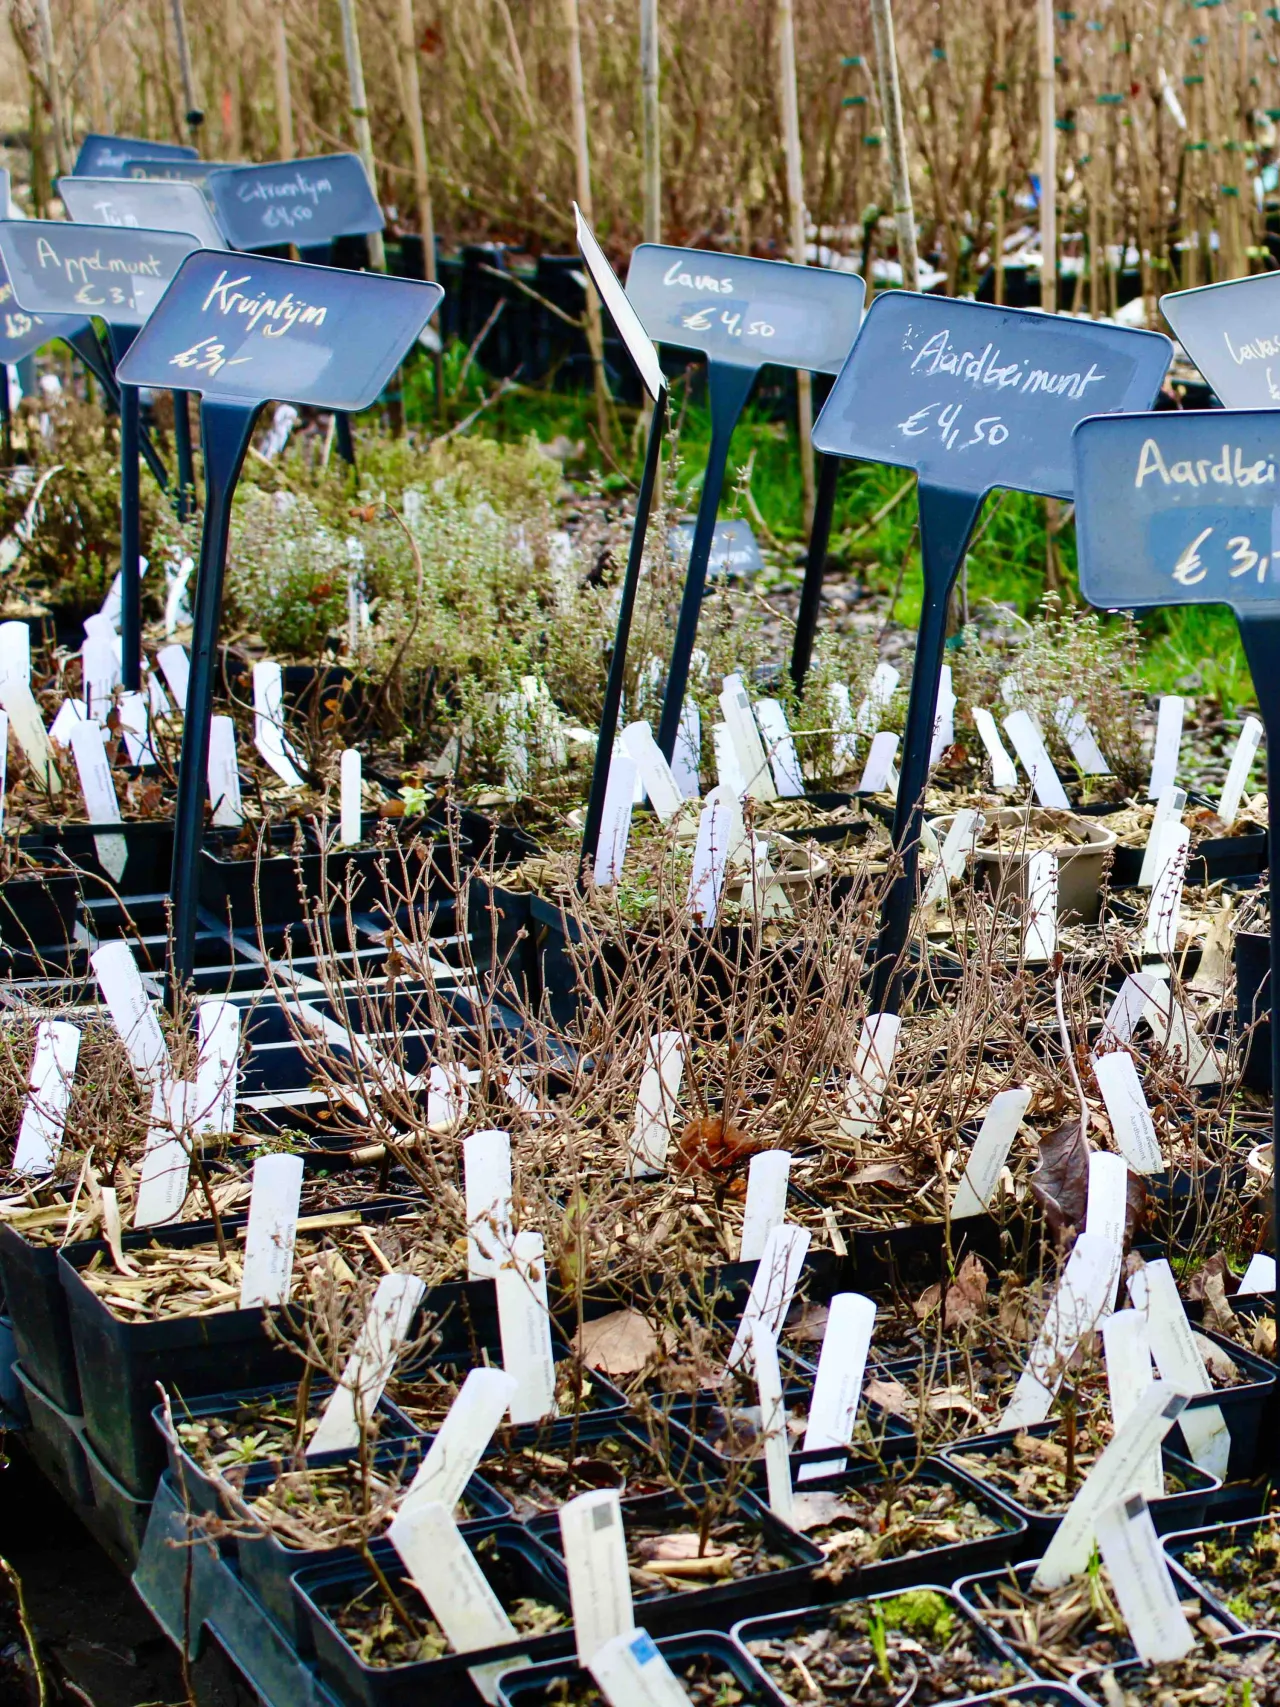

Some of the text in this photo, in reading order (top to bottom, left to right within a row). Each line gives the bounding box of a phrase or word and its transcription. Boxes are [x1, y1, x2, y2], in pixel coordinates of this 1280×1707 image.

[662, 260, 735, 295] Lavas
[910, 329, 1105, 400] Aardbeimunt
[898, 402, 1010, 451] €4,50
[1125, 1113, 1149, 1161] Aardbeimunt
[1136, 1109, 1150, 1133] Mentha
[1142, 1132, 1158, 1160] arvensis
